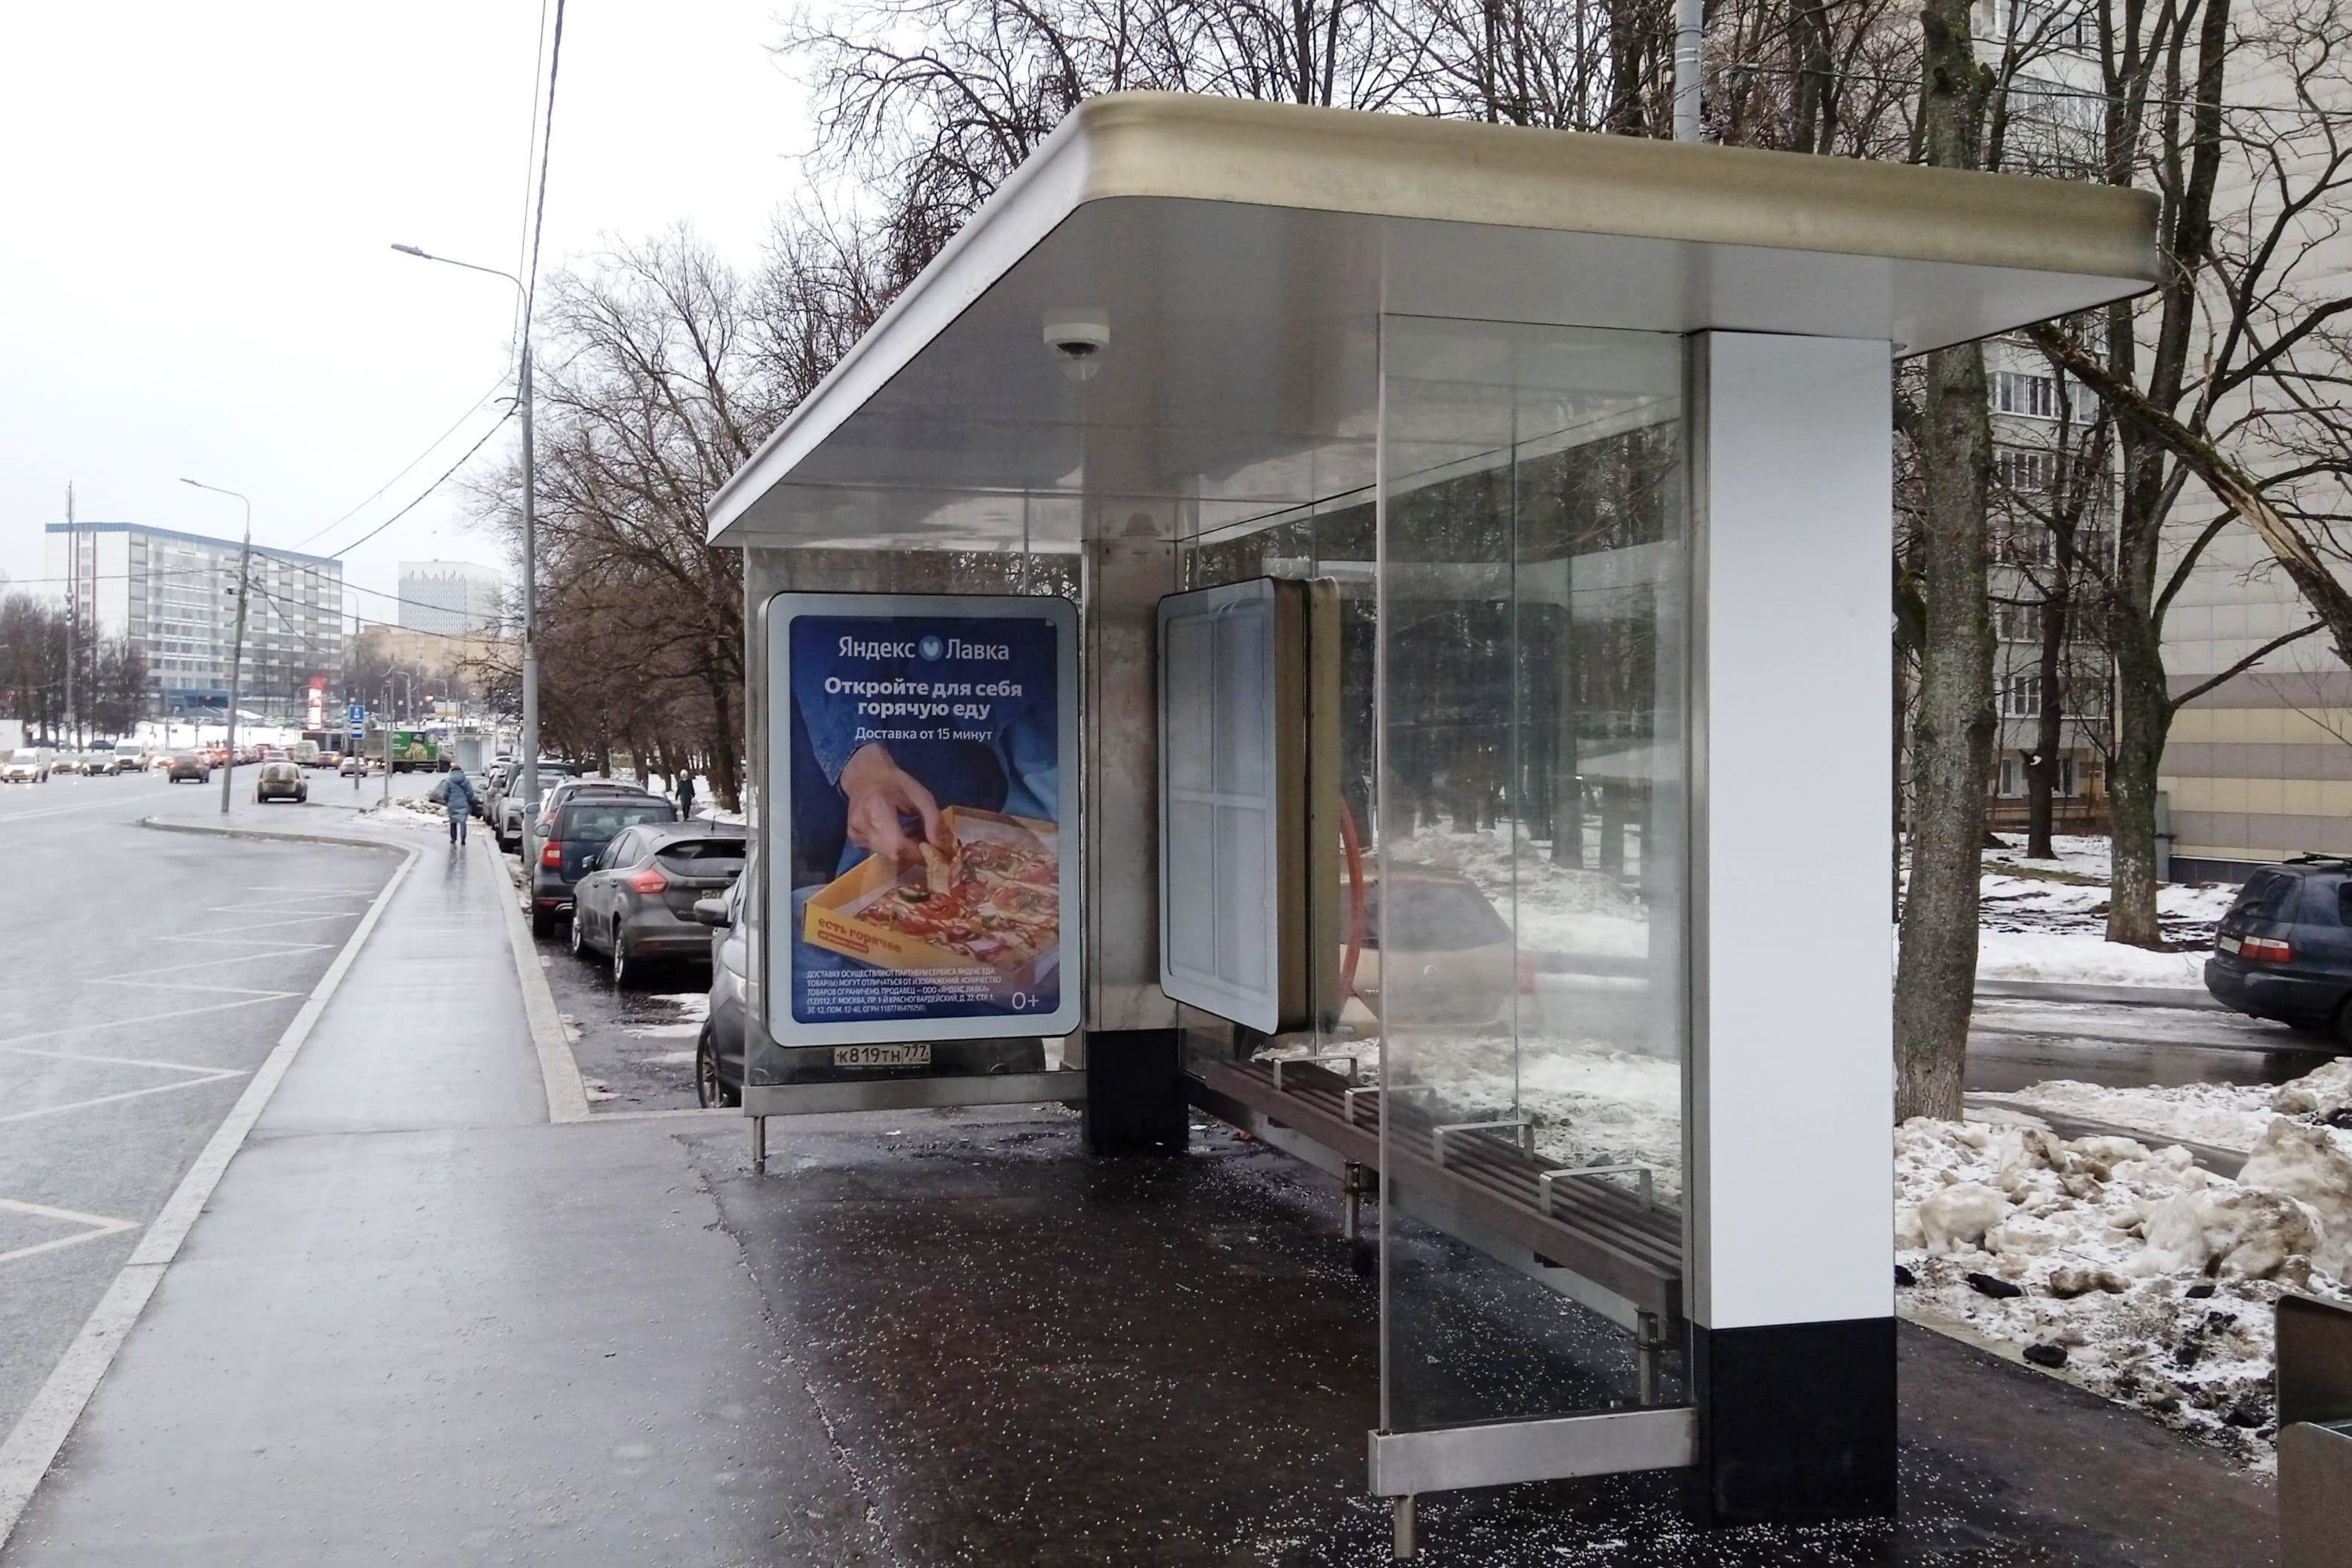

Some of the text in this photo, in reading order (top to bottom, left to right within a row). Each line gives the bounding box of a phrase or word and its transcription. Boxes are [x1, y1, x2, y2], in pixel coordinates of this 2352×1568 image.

[839, 636, 1009, 660] Яндекс Лавка
[825, 677, 1022, 697] Откройте для себя
[858, 703, 991, 720] горячую еду
[856, 727, 993, 742] Доставка от 15 минут
[818, 918, 847, 934] есть
[850, 928, 902, 954] горячее
[1012, 992, 1040, 1009] 0+
[839, 1046, 926, 1062] К819ТН 777
